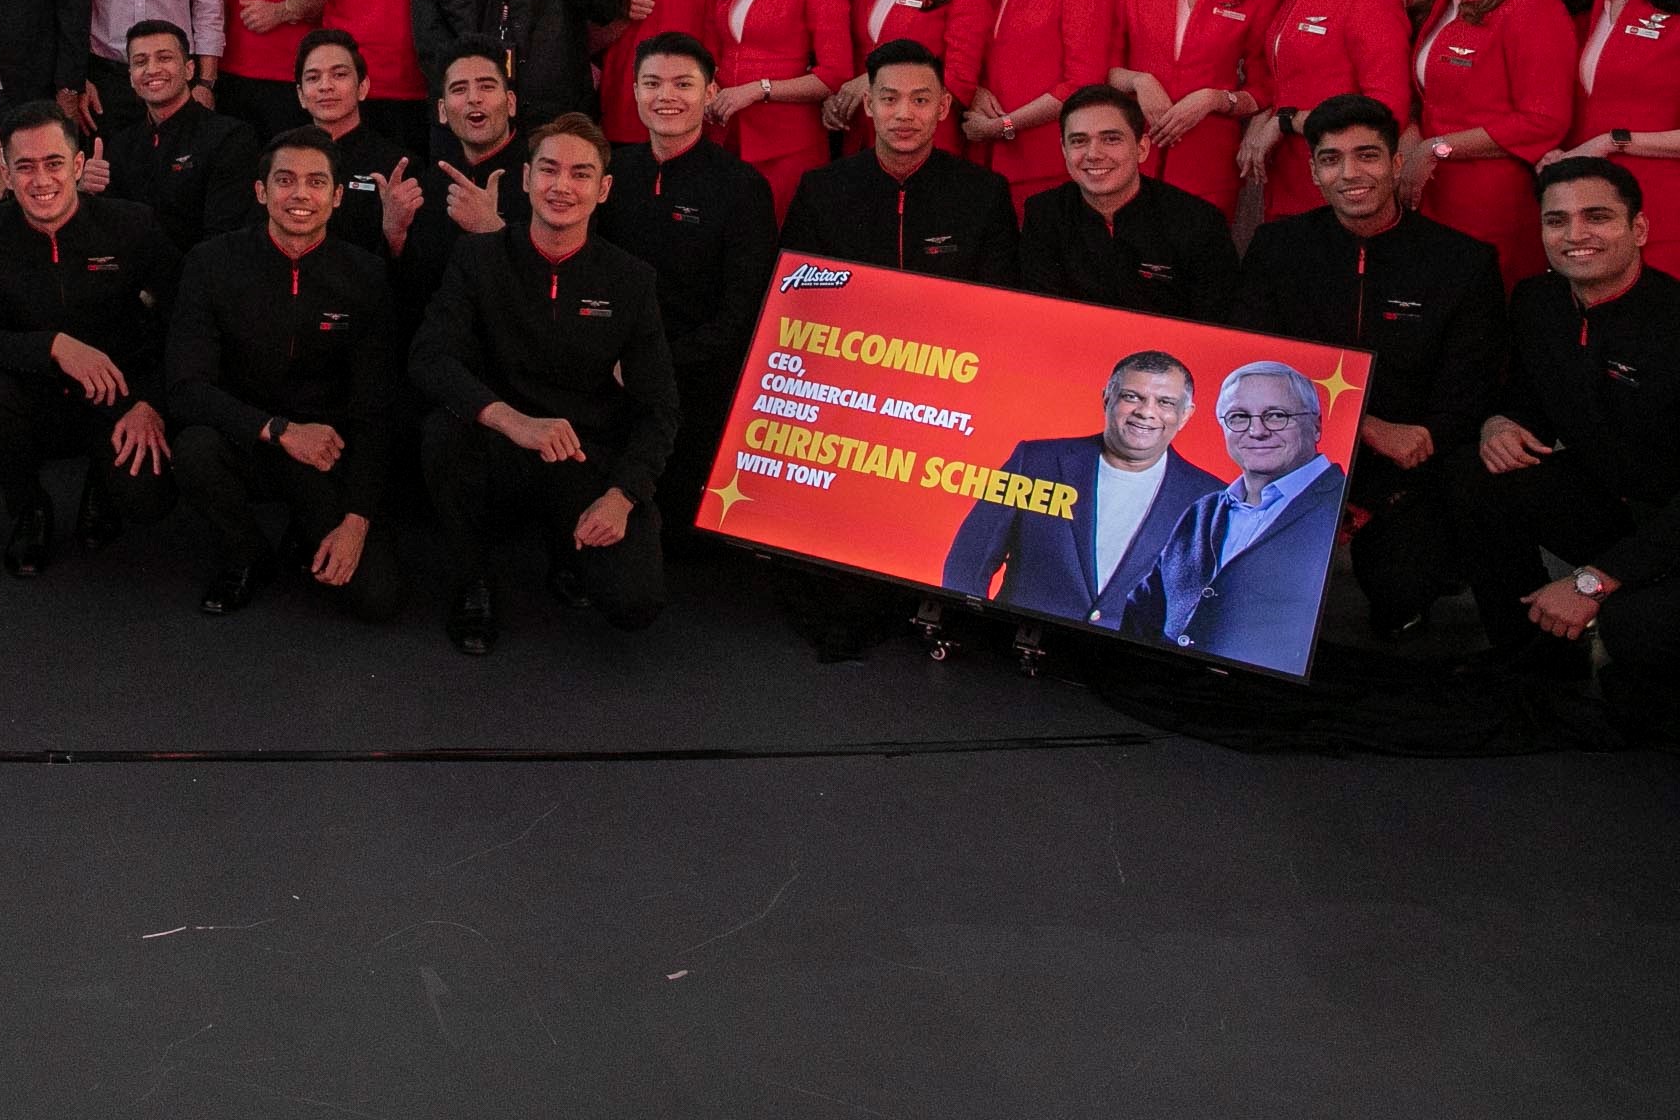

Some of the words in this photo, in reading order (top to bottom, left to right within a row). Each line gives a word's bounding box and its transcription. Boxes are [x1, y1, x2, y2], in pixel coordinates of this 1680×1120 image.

[780, 264, 851, 292] Allstars
[768, 351, 806, 377] CEO,
[779, 317, 980, 383] WELCOMING
[752, 394, 820, 423] AIRBUS
[761, 373, 876, 413] COMMERCIAL
[880, 398, 976, 436] AIRCRAFT,
[736, 451, 782, 477] WITH
[785, 463, 837, 490] TONY
[744, 418, 918, 484] CHRISTIAN
[920, 456, 1079, 521] SCHERER
